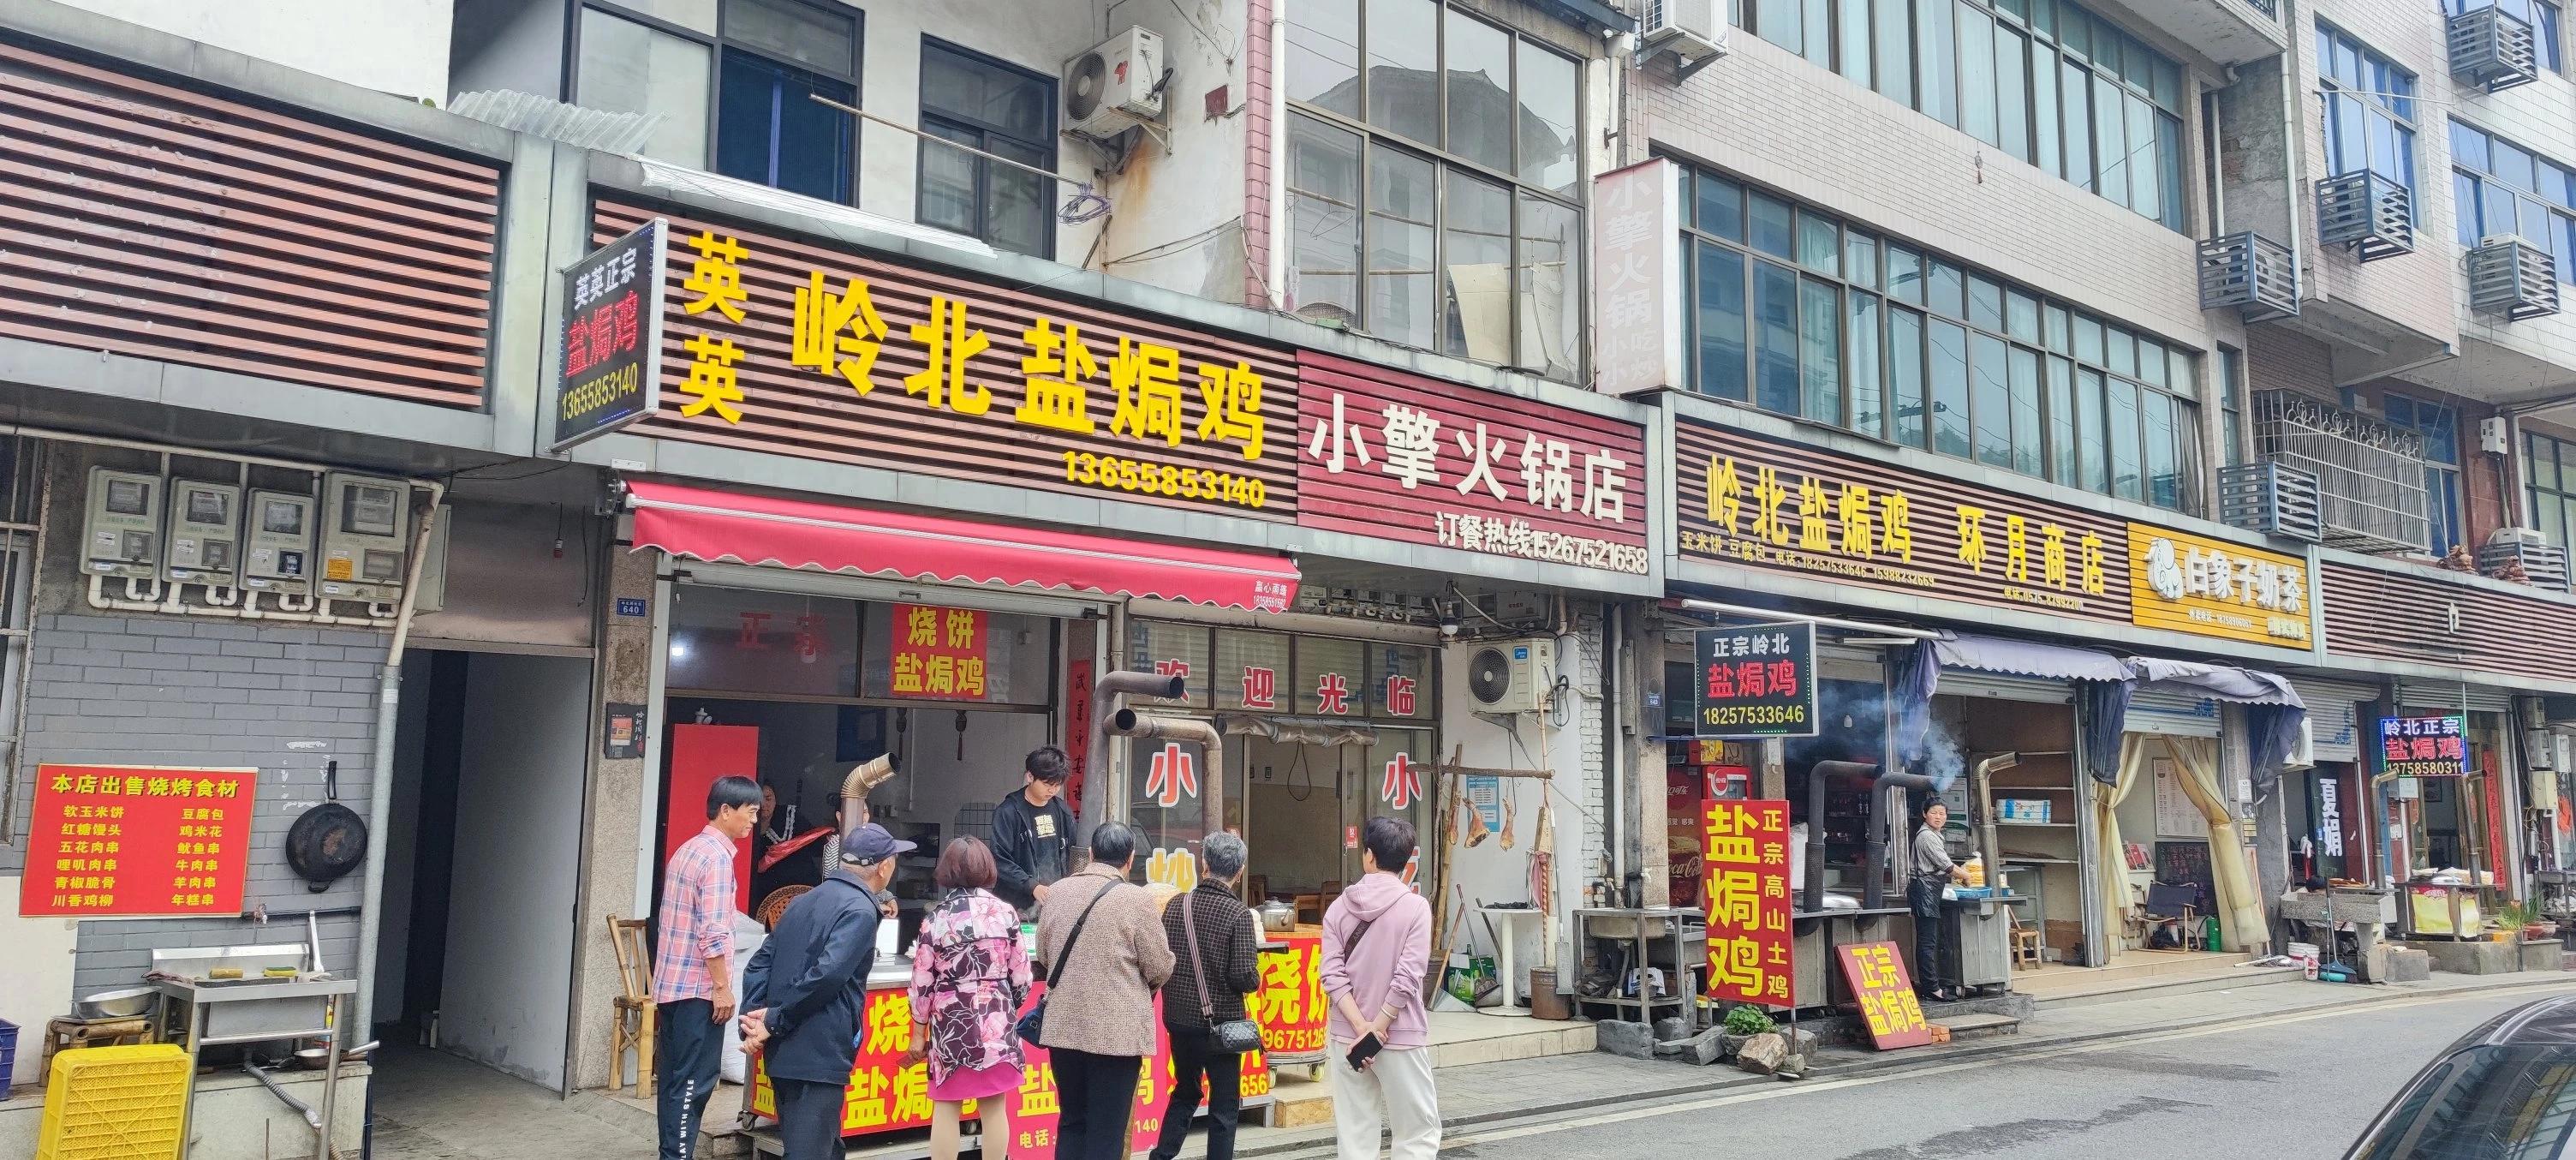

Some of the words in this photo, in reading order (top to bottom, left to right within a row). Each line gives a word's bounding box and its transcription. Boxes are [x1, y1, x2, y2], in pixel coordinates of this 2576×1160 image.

[574, 247, 637, 311] 英英正宗
[566, 290, 639, 378] 盐焗鸡
[679, 230, 749, 426] 英英
[792, 270, 1266, 461] 岭北盐焗鸡
[562, 362, 638, 422] 13655853140
[1062, 450, 1266, 508] 13655853140
[1307, 392, 1627, 524] 小擎火锅店
[1706, 454, 1911, 565] 岭北盐焗鸡
[1956, 504, 2105, 597] 环月商店
[1679, 530, 1723, 555] 玉米饼
[1728, 539, 1767, 563] 豆腐包
[1872, 567, 1935, 588] 15988232669
[2184, 547, 2304, 613] 白象子奶茶
[623, 605, 640, 614] 640
[906, 606, 975, 649] 烧饼
[1713, 632, 1790, 658] 正宗岭北
[892, 653, 986, 697] 盐焗鸡
[1708, 660, 1797, 698] 盐焗鸡
[1703, 704, 1804, 726] 18257533646
[2384, 718, 2460, 737] 岭北正宗
[2386, 736, 2464, 761] 盐焗鸡
[51, 773, 240, 798] 本店出售烧烤食材
[61, 822, 122, 837] 红糖馒头
[179, 824, 223, 838] 鸡米花
[63, 804, 125, 819] 软玉米饼
[181, 808, 224, 821] 豆腐包
[2318, 777, 2343, 857] 夏娟
[58, 840, 120, 855] 五花肉串
[177, 841, 220, 855] 鱿鱼串
[176, 858, 218, 872] 牛肉串
[51, 894, 114, 908] 川香鸡柳
[170, 894, 215, 907] 年糕串
[54, 876, 116, 890] 青椒脆骨
[173, 876, 217, 889] 羊肉串
[1705, 804, 1763, 997] 盐焗鸡
[1762, 810, 1789, 999] 正宗高山土鸡
[1851, 943, 1901, 989] 正宗
[1859, 986, 1927, 1037] 盐焗鸡
[683, 1079, 695, 1110] STYLE
[680, 1113, 689, 1139] WITH
